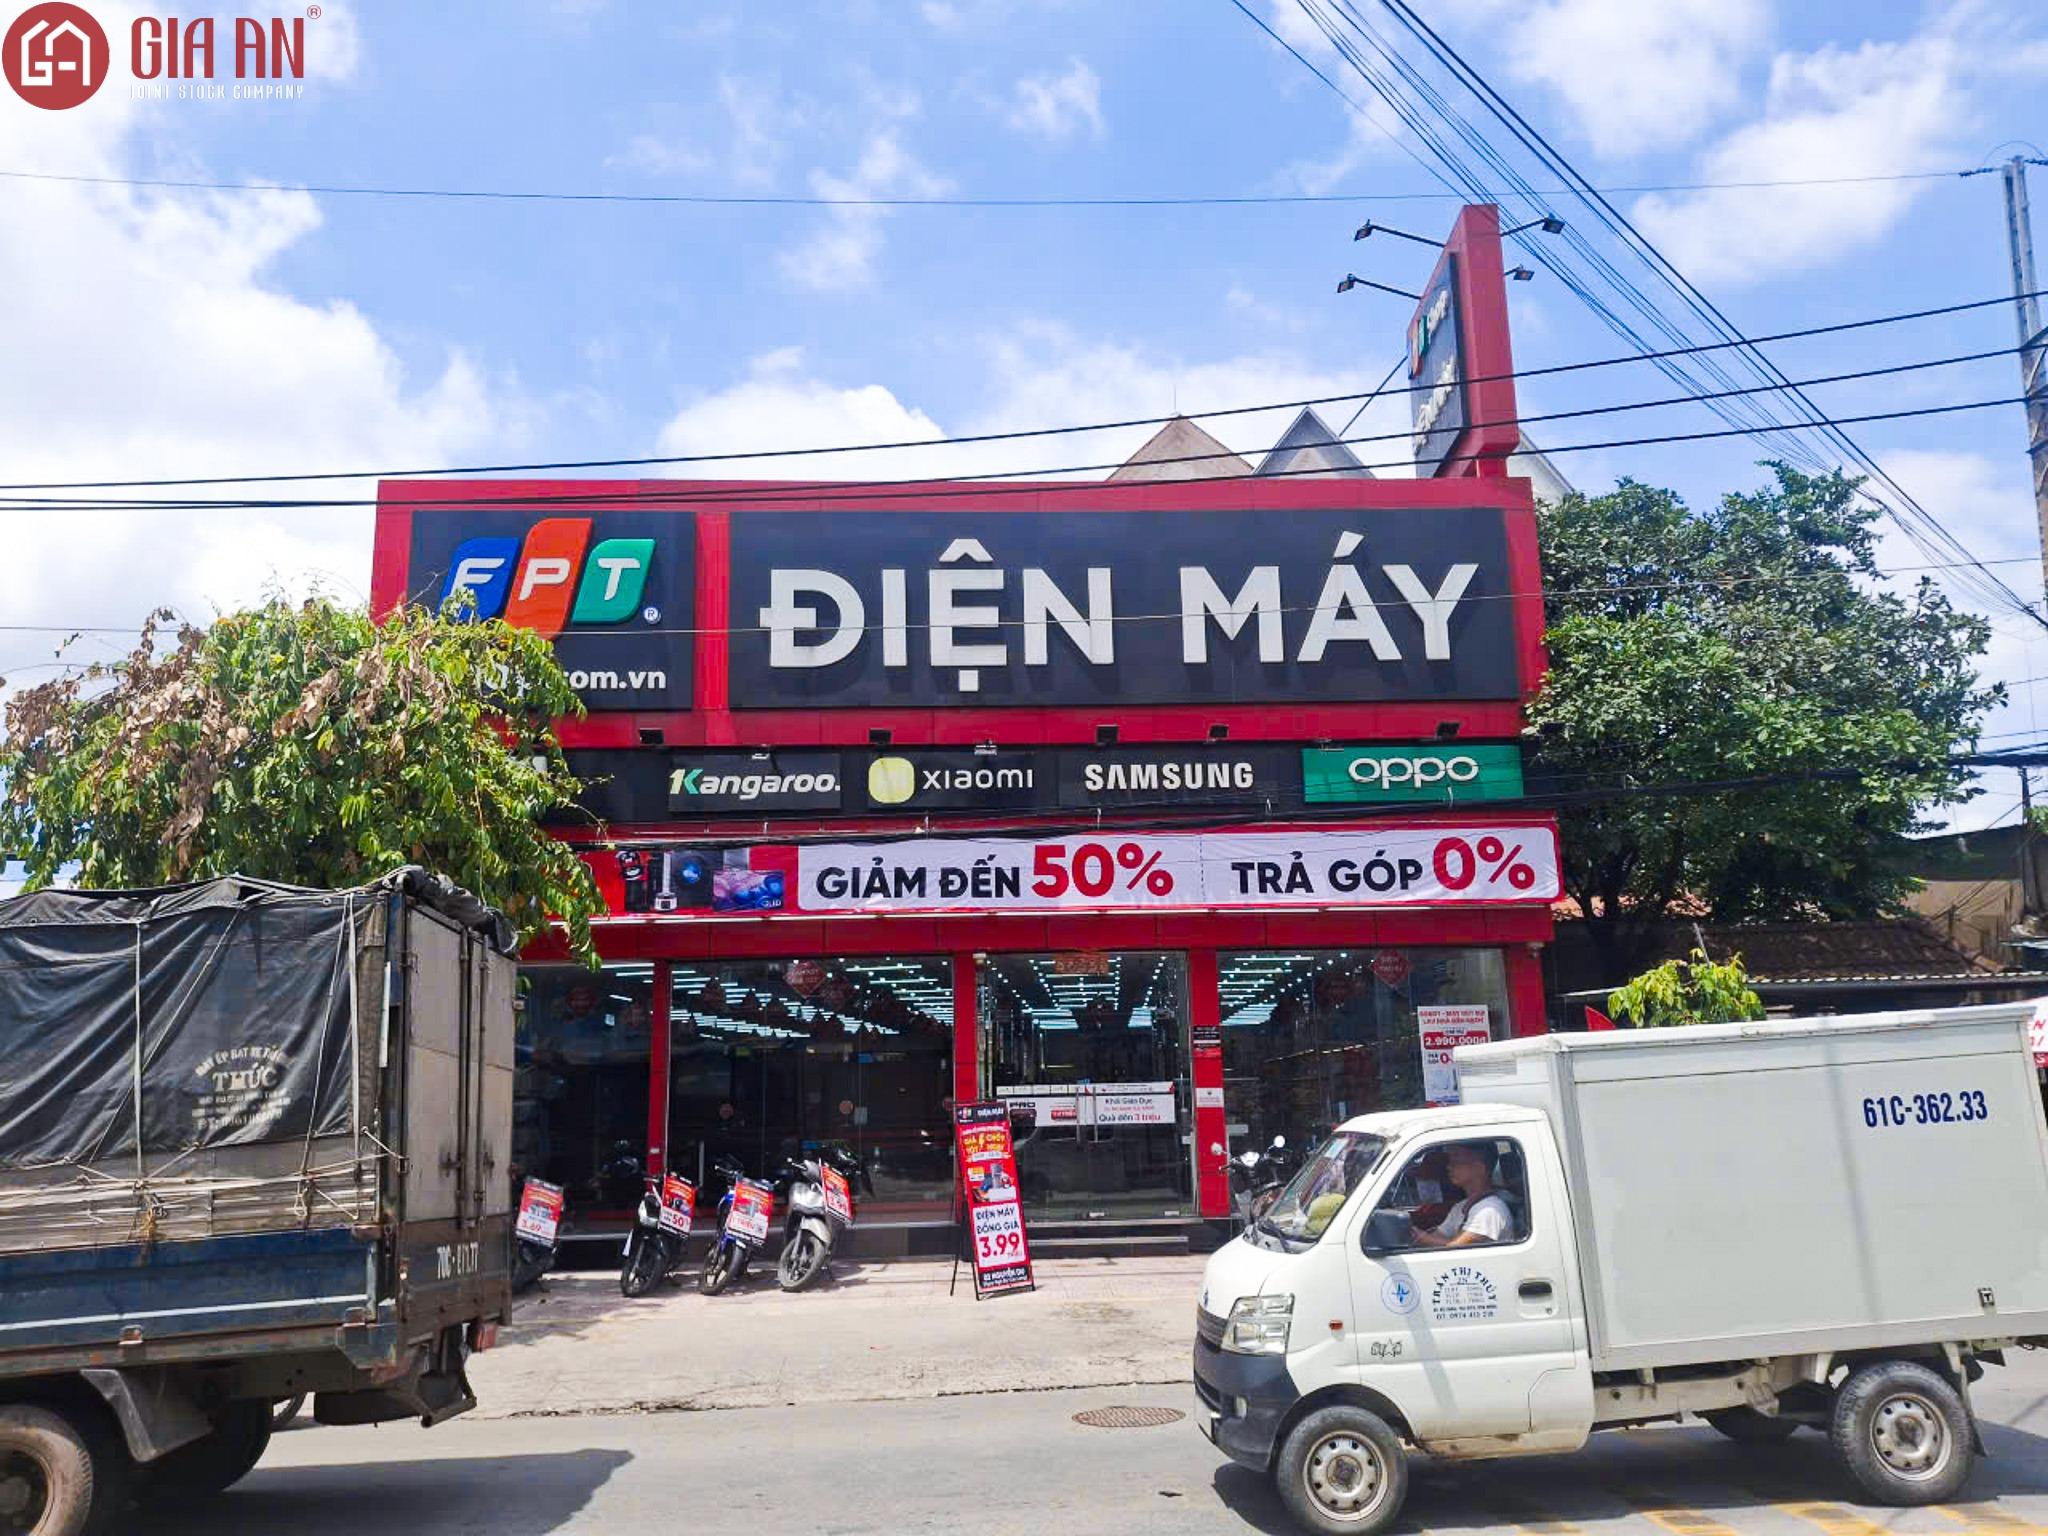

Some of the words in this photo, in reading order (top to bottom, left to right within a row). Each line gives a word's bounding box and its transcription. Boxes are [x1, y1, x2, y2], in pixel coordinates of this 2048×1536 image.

[449, 557, 641, 601] FPT
[760, 538, 1114, 692] ĐIỆN
[1179, 530, 1480, 664] MÁY
[1085, 762, 1254, 791] SAMSUNG
[816, 856, 926, 899] GIẢM
[939, 854, 1020, 898] ĐẾN
[1031, 843, 1174, 898] 50%
[1231, 851, 1314, 894] TRẢ
[1328, 849, 1423, 892] GÓP
[1432, 836, 1536, 891] 0%
[1863, 1090, 1988, 1127] 61C-362.33
[976, 1208, 995, 1220] ĐIỆN
[997, 1205, 1015, 1217] MÁY
[1003, 1219, 1020, 1231] GIÁ
[979, 1232, 1020, 1258] 3.99
